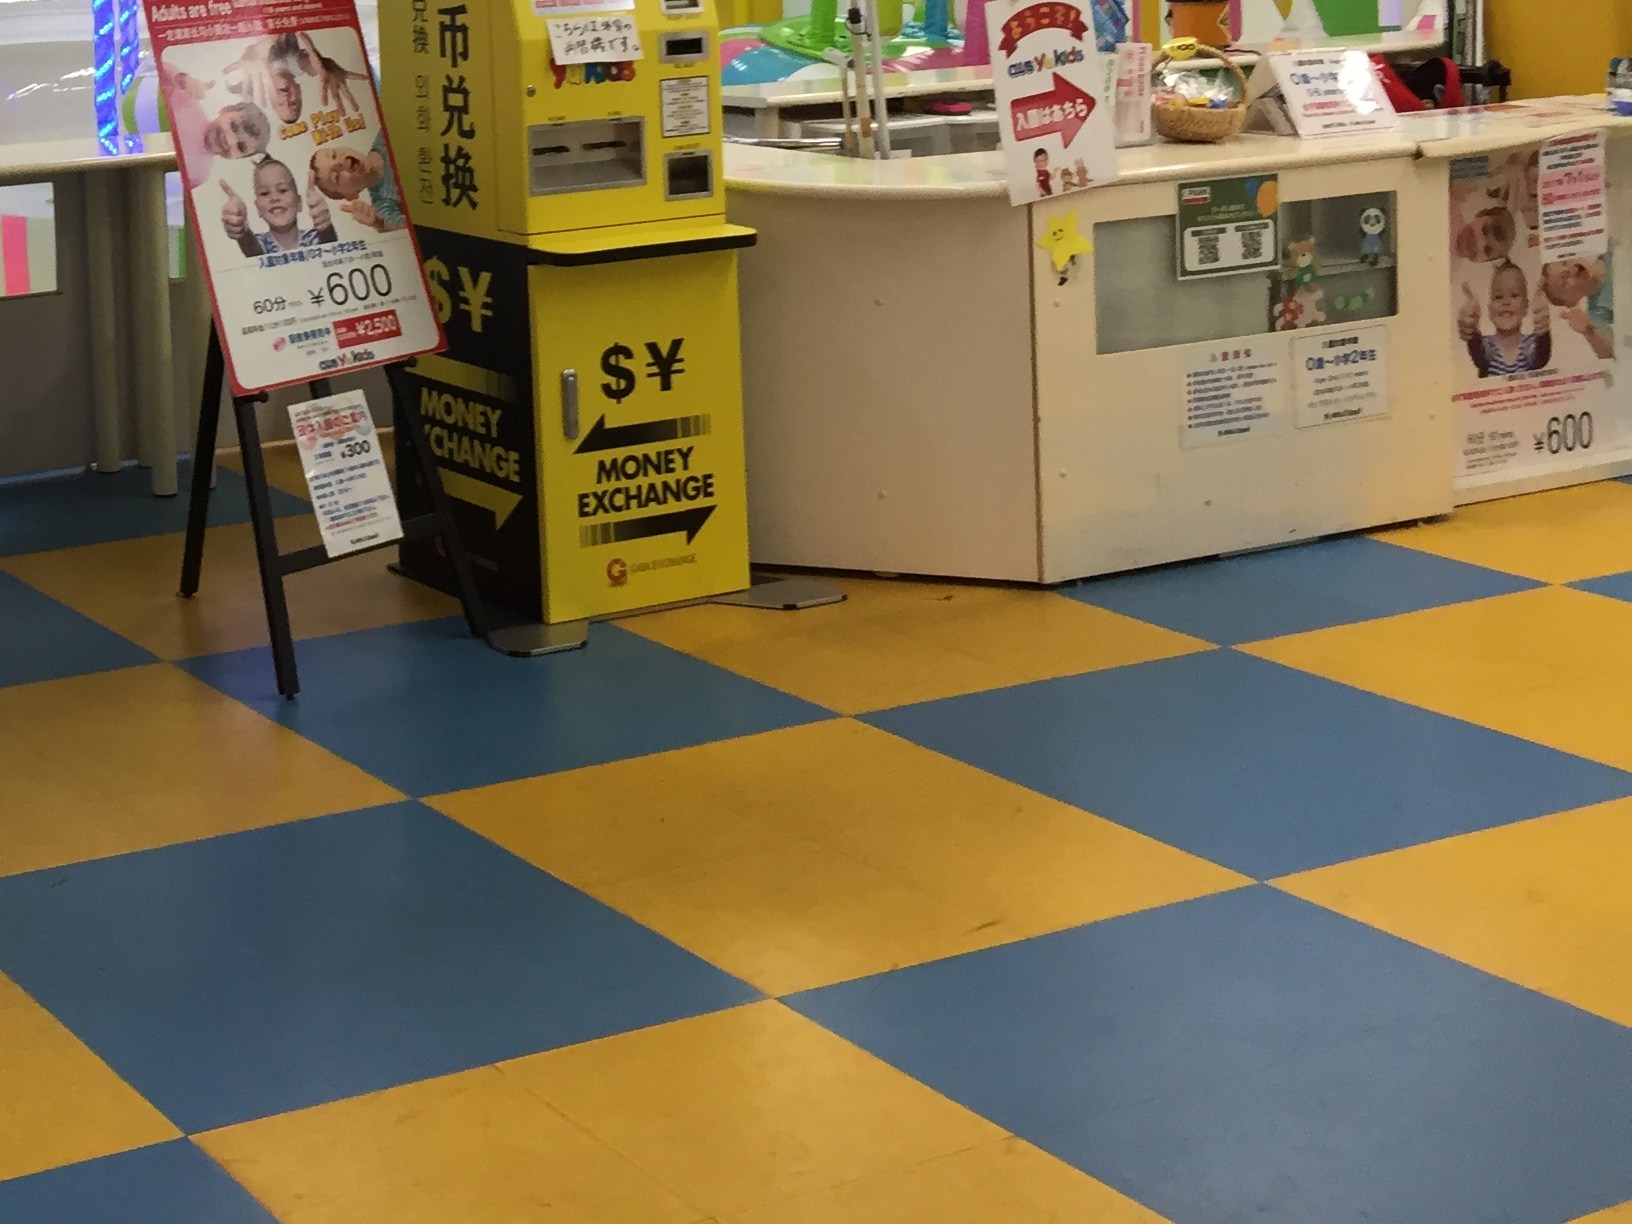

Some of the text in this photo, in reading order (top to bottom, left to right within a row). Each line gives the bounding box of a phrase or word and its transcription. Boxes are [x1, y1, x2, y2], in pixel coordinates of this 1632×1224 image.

[188, 5, 207, 18] are
[209, 0, 232, 15] free
[420, 387, 502, 438] MONEY
[596, 446, 694, 484] MONEY
[578, 473, 715, 518] EXCHANGE
